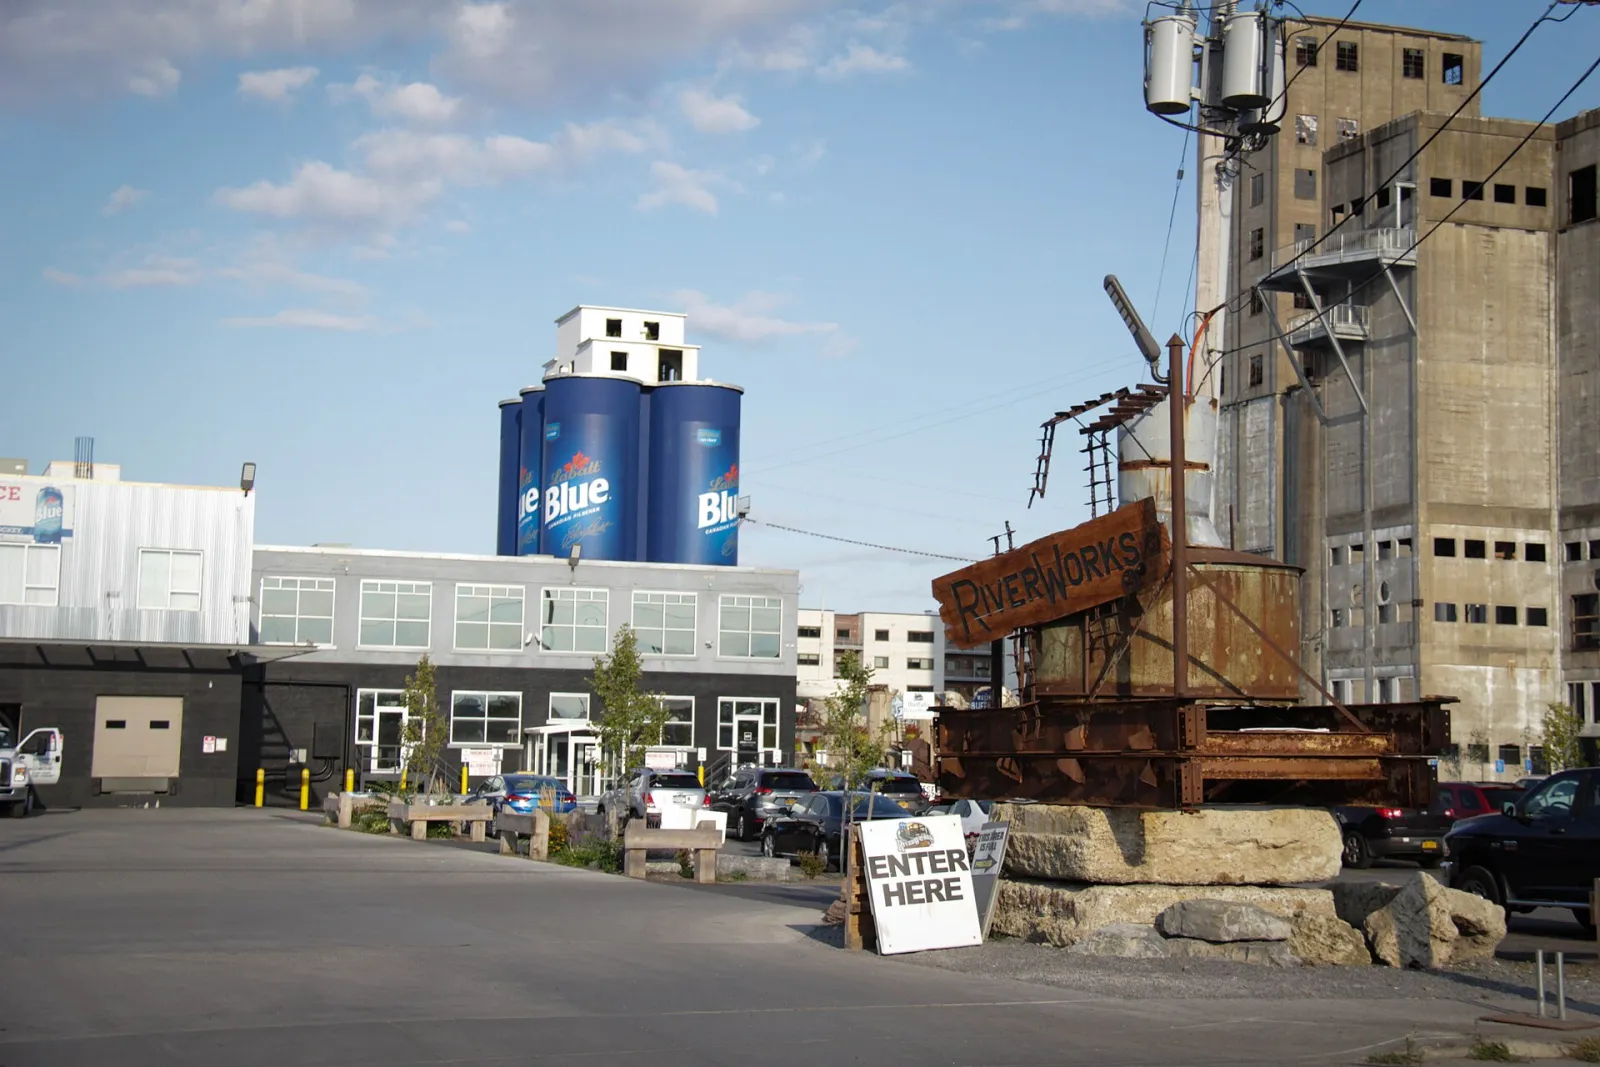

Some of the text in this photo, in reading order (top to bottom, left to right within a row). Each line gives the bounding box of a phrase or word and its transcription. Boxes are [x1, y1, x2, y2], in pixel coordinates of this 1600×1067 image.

[545, 478, 610, 525] Blue
[978, 832, 991, 843] THIS
[985, 842, 997, 852] FULL
[868, 849, 969, 880] ENTER
[882, 877, 964, 907] HERE
